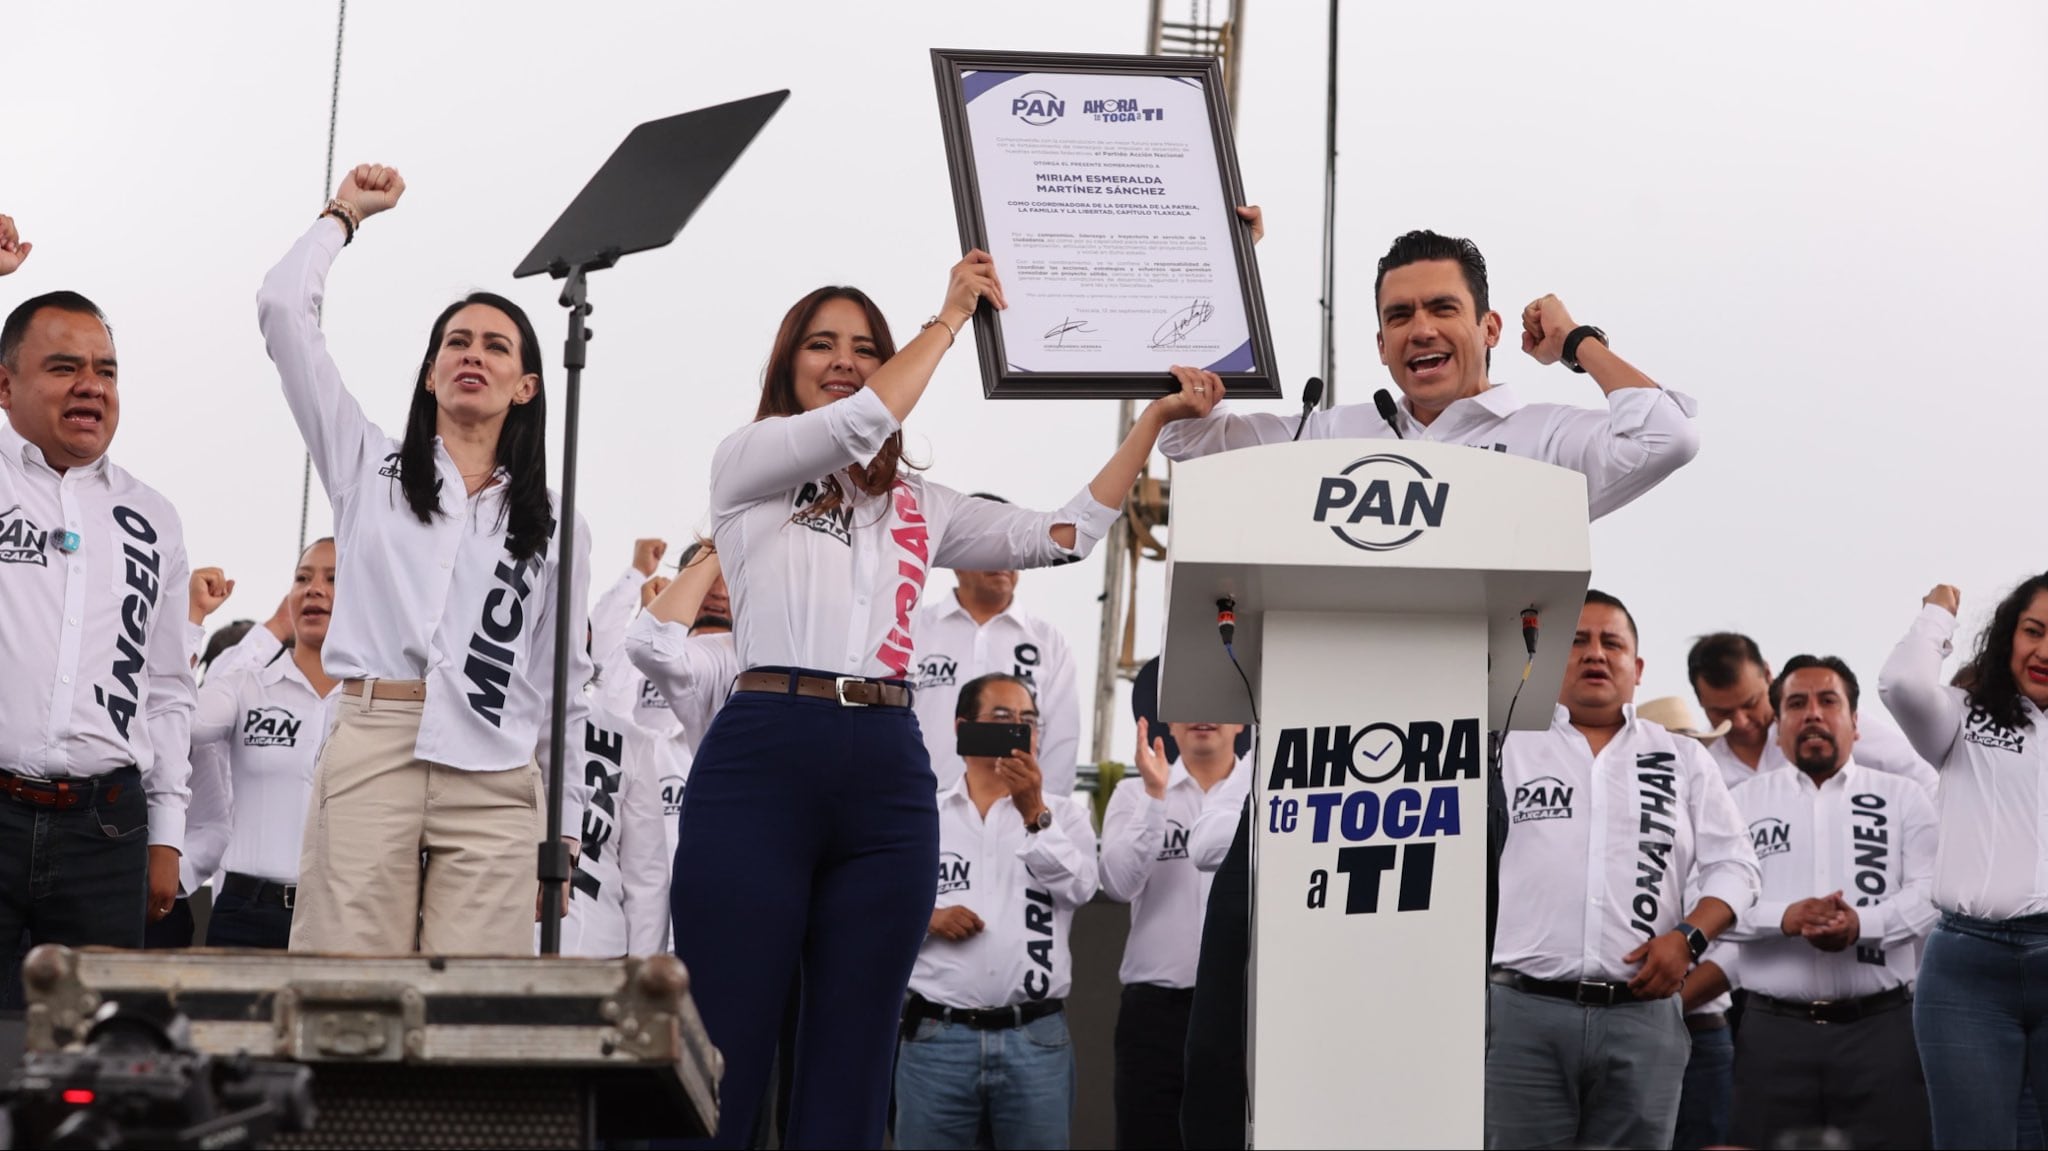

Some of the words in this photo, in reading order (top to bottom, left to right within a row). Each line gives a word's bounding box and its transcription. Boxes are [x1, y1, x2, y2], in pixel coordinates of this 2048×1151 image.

[1012, 99, 1065, 118] PAN
[1083, 98, 1138, 114] AHORA
[1102, 112, 1136, 122] TOCA
[1142, 108, 1164, 121] TI
[1036, 173, 1082, 182] MIRIAM
[1086, 174, 1162, 184] ESMERALDA
[1036, 184, 1102, 194] MARTÍNEZ
[1106, 184, 1166, 195] SÁNCHEZ
[1312, 477, 1450, 528] PAN
[94, 505, 160, 742] ÁNGELO
[244, 710, 302, 738] PAN
[1268, 718, 1480, 790] AHORA
[1512, 786, 1574, 811] PAN
[1269, 795, 1298, 833] te
[1307, 786, 1460, 843] TOCA
[1632, 752, 1678, 940] JONATHAN
[940, 861, 970, 882] AN
[1307, 868, 1328, 909] a
[1337, 842, 1436, 915] TI
[1024, 862, 1052, 1000] CARL
